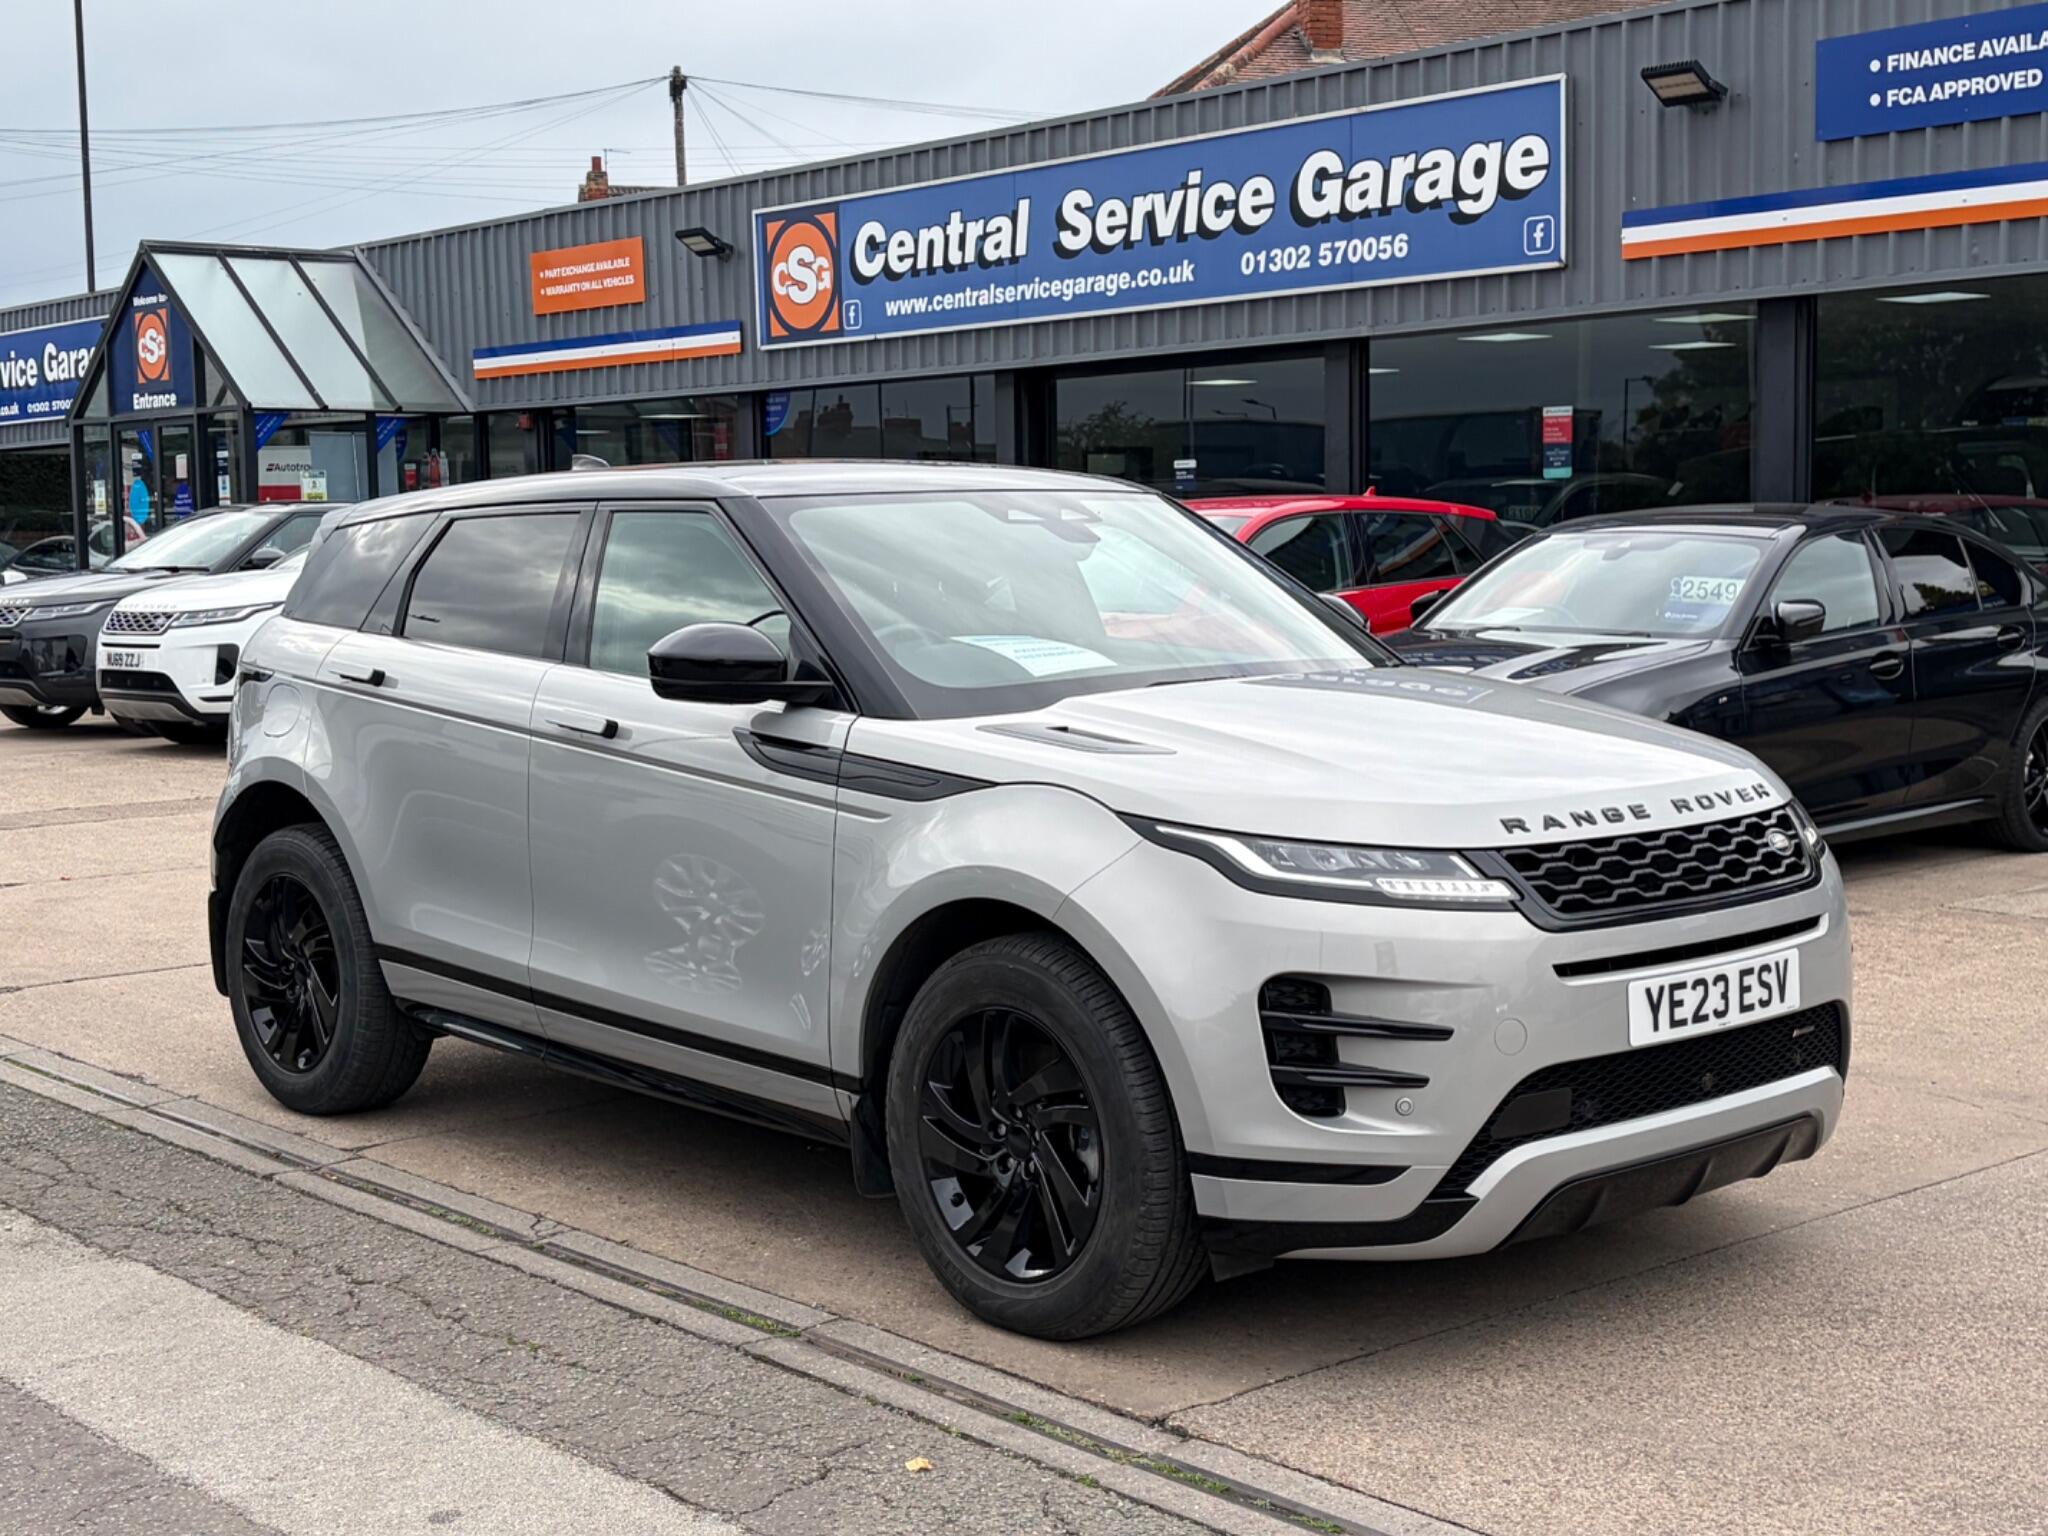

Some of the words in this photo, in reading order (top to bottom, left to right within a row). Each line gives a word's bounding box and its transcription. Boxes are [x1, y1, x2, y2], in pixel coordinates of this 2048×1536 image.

[1887, 42, 1976, 73] FINANCE
[1887, 86, 1927, 107] FCA
[1929, 68, 2043, 101] APPROVED
[854, 197, 1031, 278] Central
[1058, 168, 1275, 251] Service
[1296, 133, 1550, 220] Garage
[544, 267, 561, 279] PART
[561, 261, 596, 277] EXCHANGE
[596, 257, 630, 271] AVAILABLE
[1241, 244, 1311, 275] 01302
[1318, 232, 1409, 266] 570056
[545, 282, 581, 297] WARRANTY
[580, 280, 591, 292] ON
[591, 278, 603, 290] ALL
[602, 274, 635, 289] VEHICLES
[885, 259, 1196, 317] www.centralservicegarage.co.uk
[51, 398, 73, 411] 5700
[132, 392, 178, 411] Entrance
[1500, 803, 1652, 834] RANGE
[1670, 783, 1771, 814] ROVER
[1645, 973, 1730, 1033] YE23
[1739, 957, 1789, 1014] ESV
